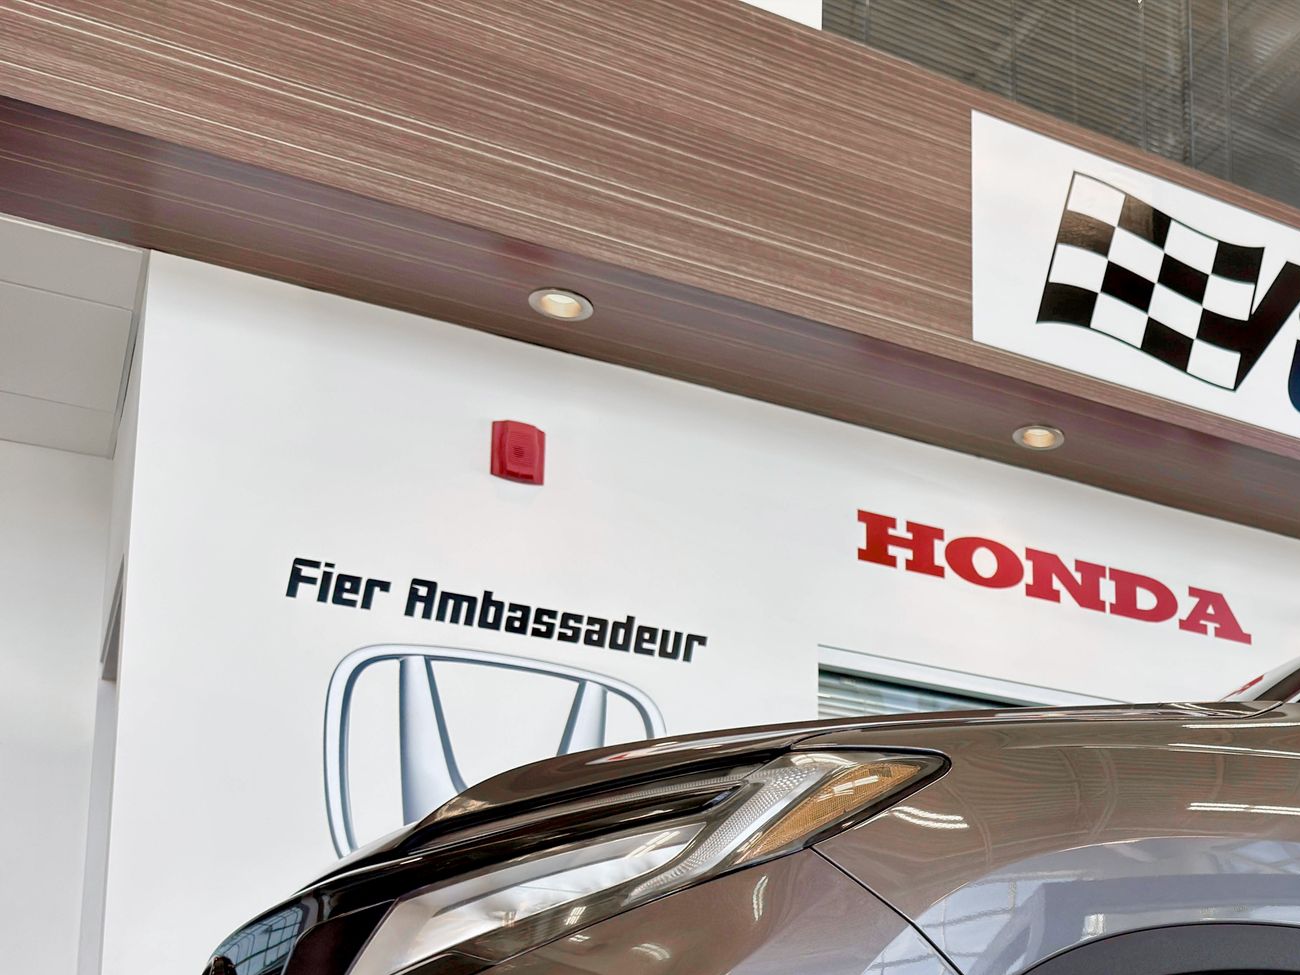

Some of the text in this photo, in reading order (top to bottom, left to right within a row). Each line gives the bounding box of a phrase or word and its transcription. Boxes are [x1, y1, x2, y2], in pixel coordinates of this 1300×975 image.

[286, 557, 707, 662] Fier Ambassadeur
[857, 509, 1252, 645] HONDA
